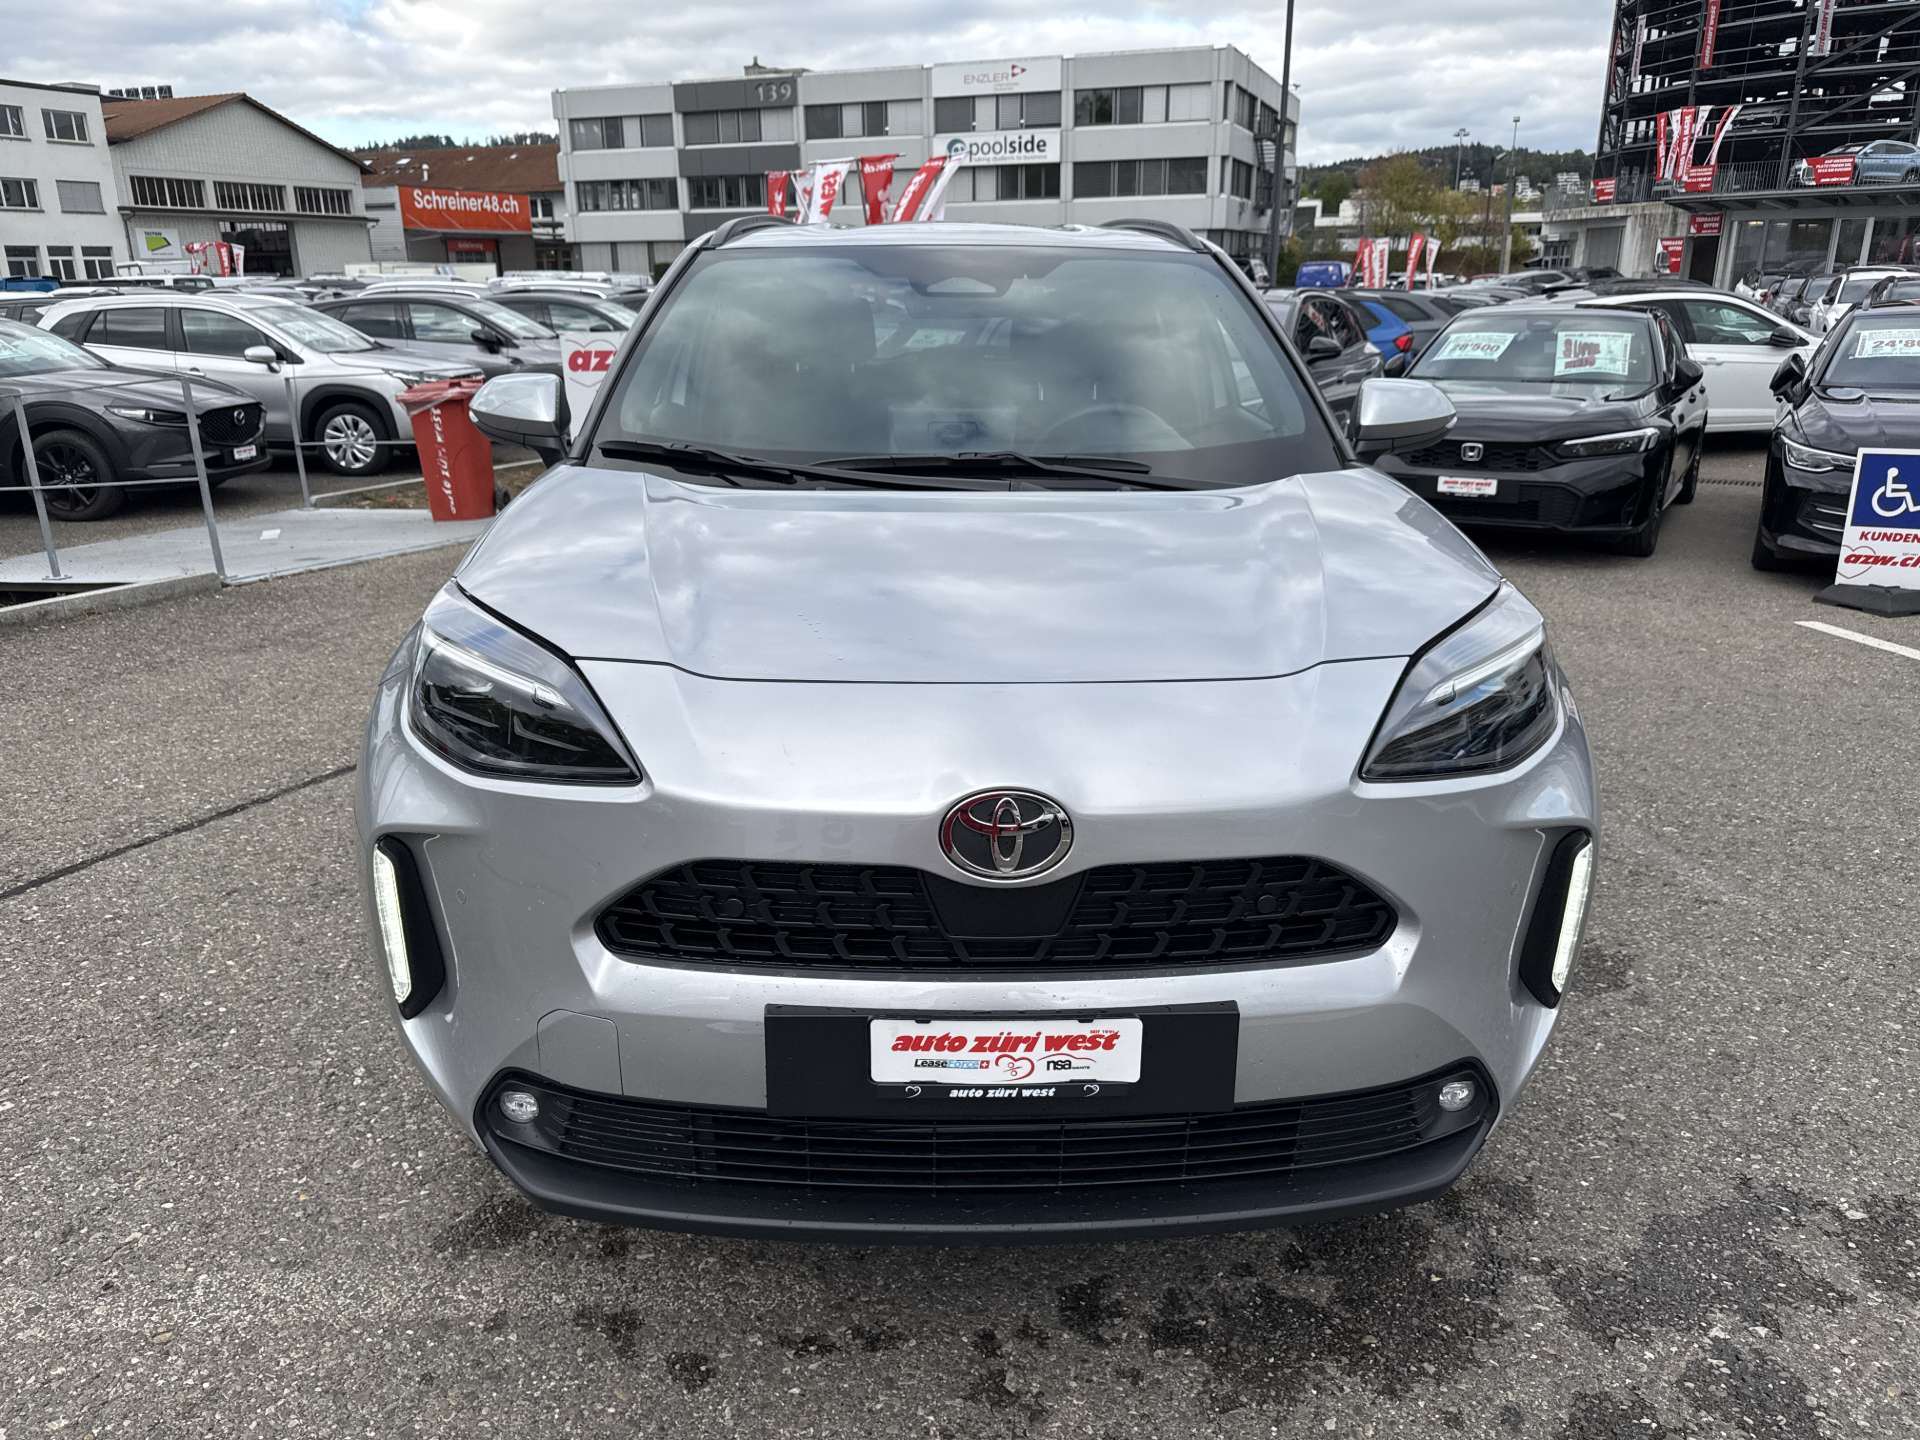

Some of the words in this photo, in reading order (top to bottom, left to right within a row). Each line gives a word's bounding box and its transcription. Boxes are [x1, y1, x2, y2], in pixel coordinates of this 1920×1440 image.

[964, 72, 1009, 85] ENZLER
[757, 83, 791, 102] 139
[969, 134, 1047, 162] poolside
[413, 189, 519, 214] Schreiner48.ch
[1872, 339, 1920, 349] 24'8
[568, 350, 617, 373] az
[891, 1032, 968, 1053] auto
[968, 1031, 1042, 1053] züri
[1044, 1031, 1120, 1052] west
[914, 1058, 979, 1069] LeaseForce
[1046, 1059, 1072, 1071] nsa
[949, 1088, 984, 1098] auto
[986, 1087, 1019, 1098] züri
[1021, 1087, 1056, 1097] west
